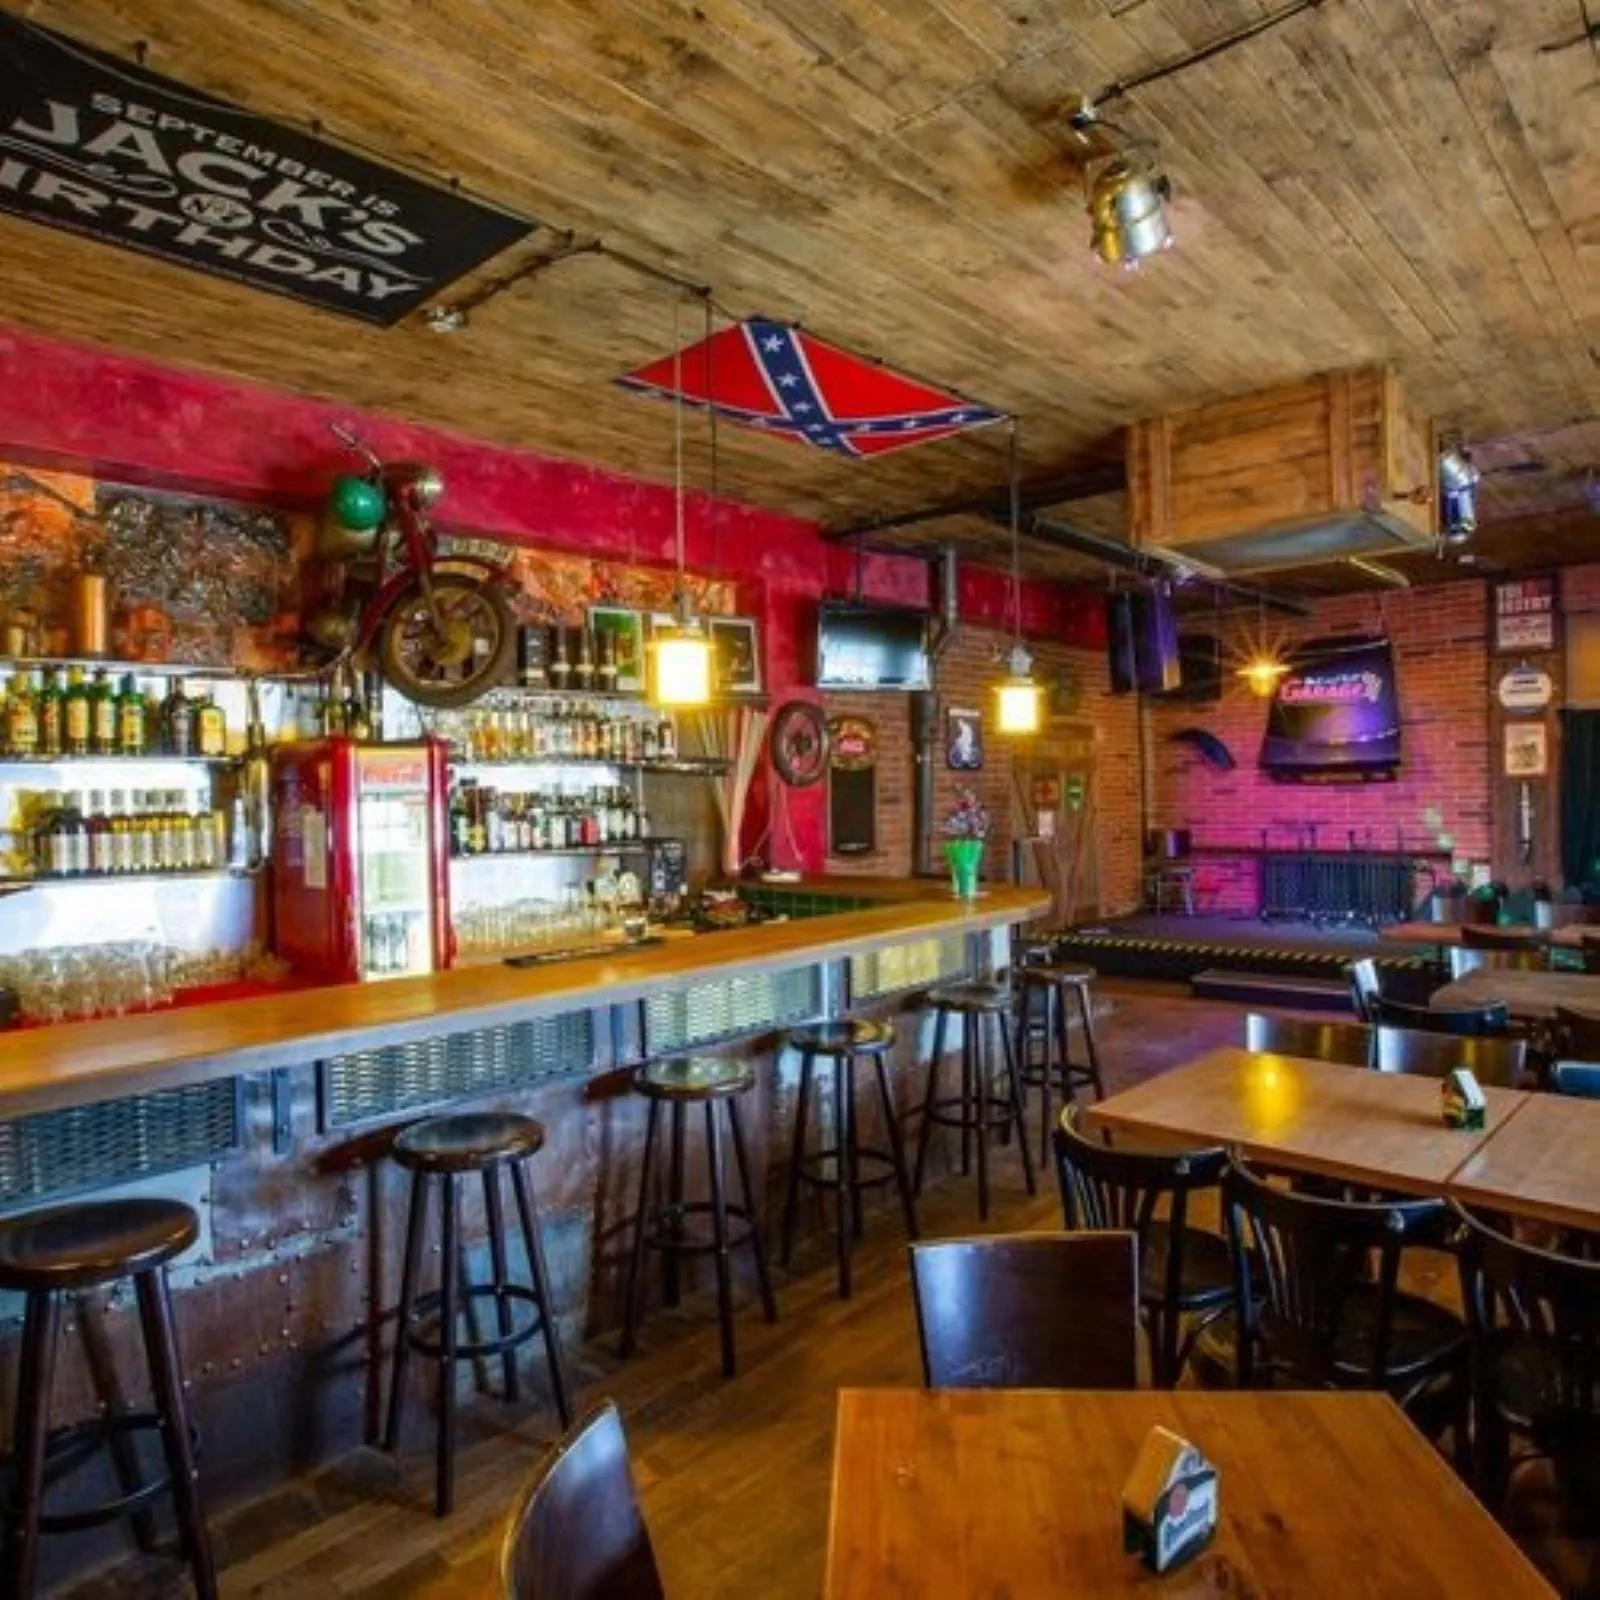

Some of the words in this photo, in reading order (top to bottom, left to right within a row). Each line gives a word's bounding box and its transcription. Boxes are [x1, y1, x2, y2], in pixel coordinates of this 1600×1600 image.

[10, 98, 425, 255] JACK'S
[90, 92, 357, 198] SEPTEMBER
[360, 194, 399, 217] IS
[0, 157, 422, 299] IRTHDAY
